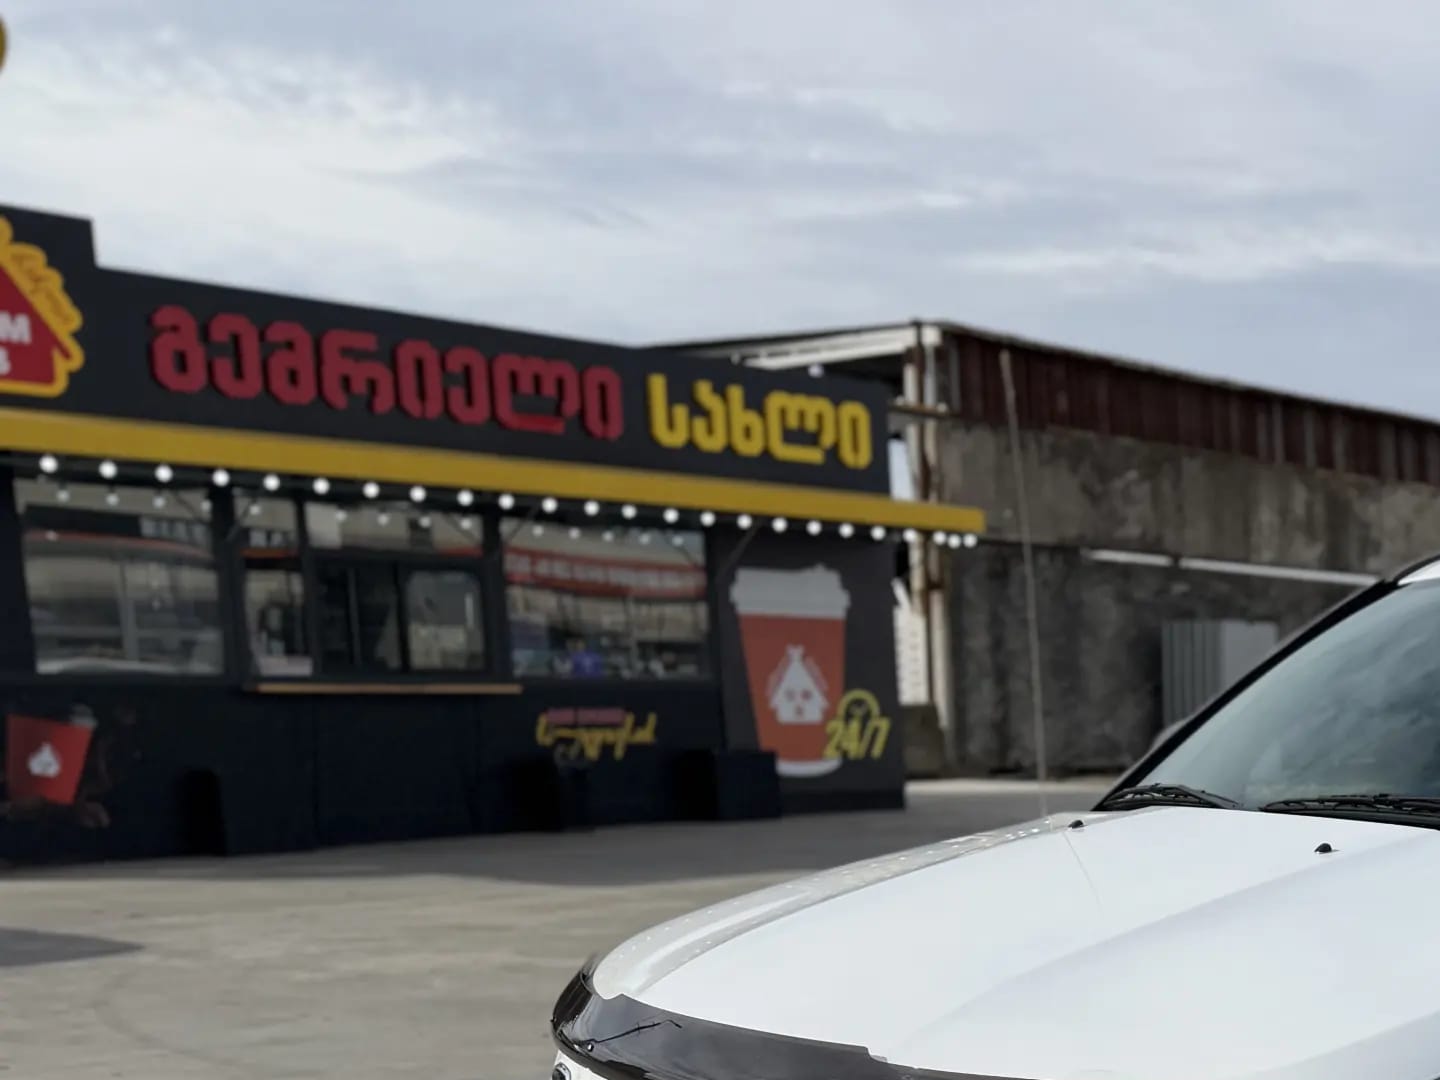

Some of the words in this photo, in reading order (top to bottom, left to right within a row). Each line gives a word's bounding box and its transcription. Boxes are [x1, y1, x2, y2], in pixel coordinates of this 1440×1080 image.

[151, 305, 624, 440] გემრიელი
[647, 373, 872, 470] სახლი
[823, 716, 890, 759] 24/7
